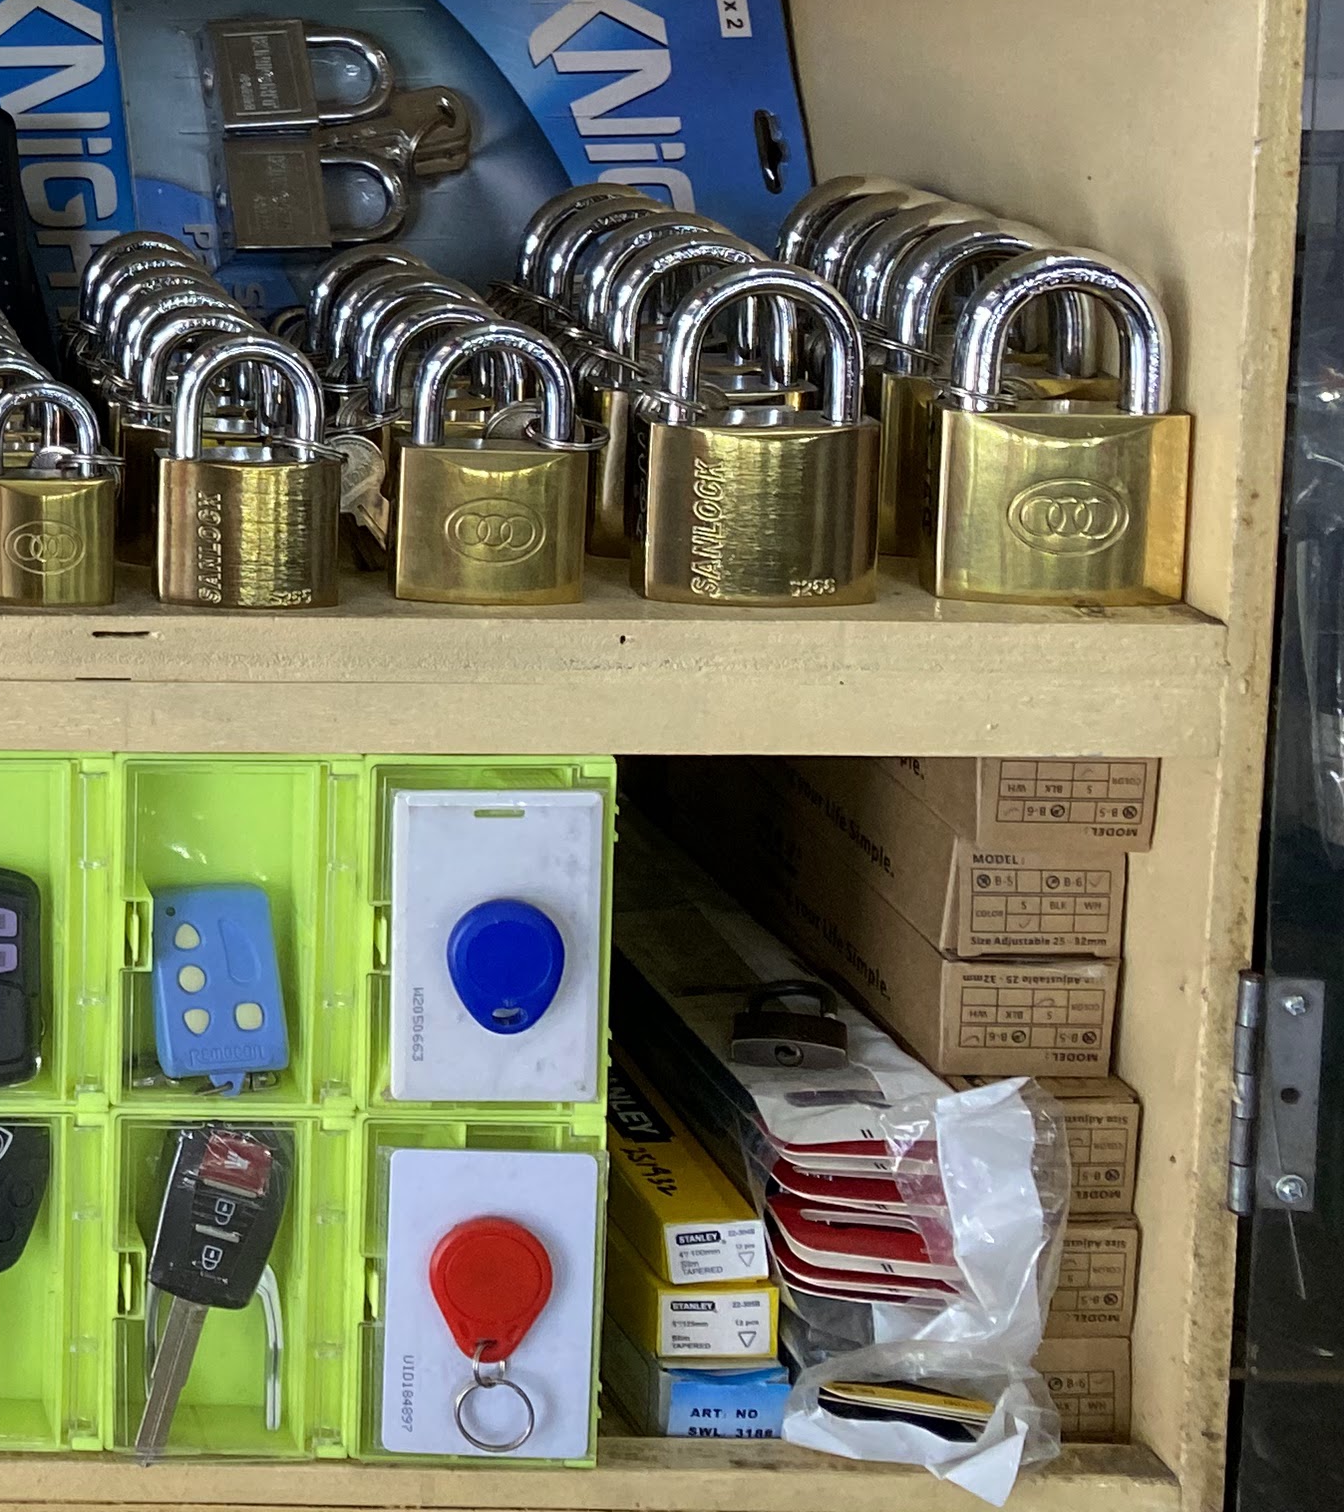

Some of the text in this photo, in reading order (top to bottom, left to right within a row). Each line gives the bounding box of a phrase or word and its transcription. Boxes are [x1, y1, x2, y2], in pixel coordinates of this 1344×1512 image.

[724, 1, 738, 12] x
[690, 458, 723, 599] SANLOCK
[198, 491, 221, 603] SANLOCK
[994, 937, 1050, 947] Adjustable
[411, 986, 424, 1062] W2050663
[679, 1234, 718, 1243] STANLEY
[672, 1302, 713, 1310] STANLEY
[401, 1354, 414, 1434] UID184897
[736, 1409, 758, 1418] NO
